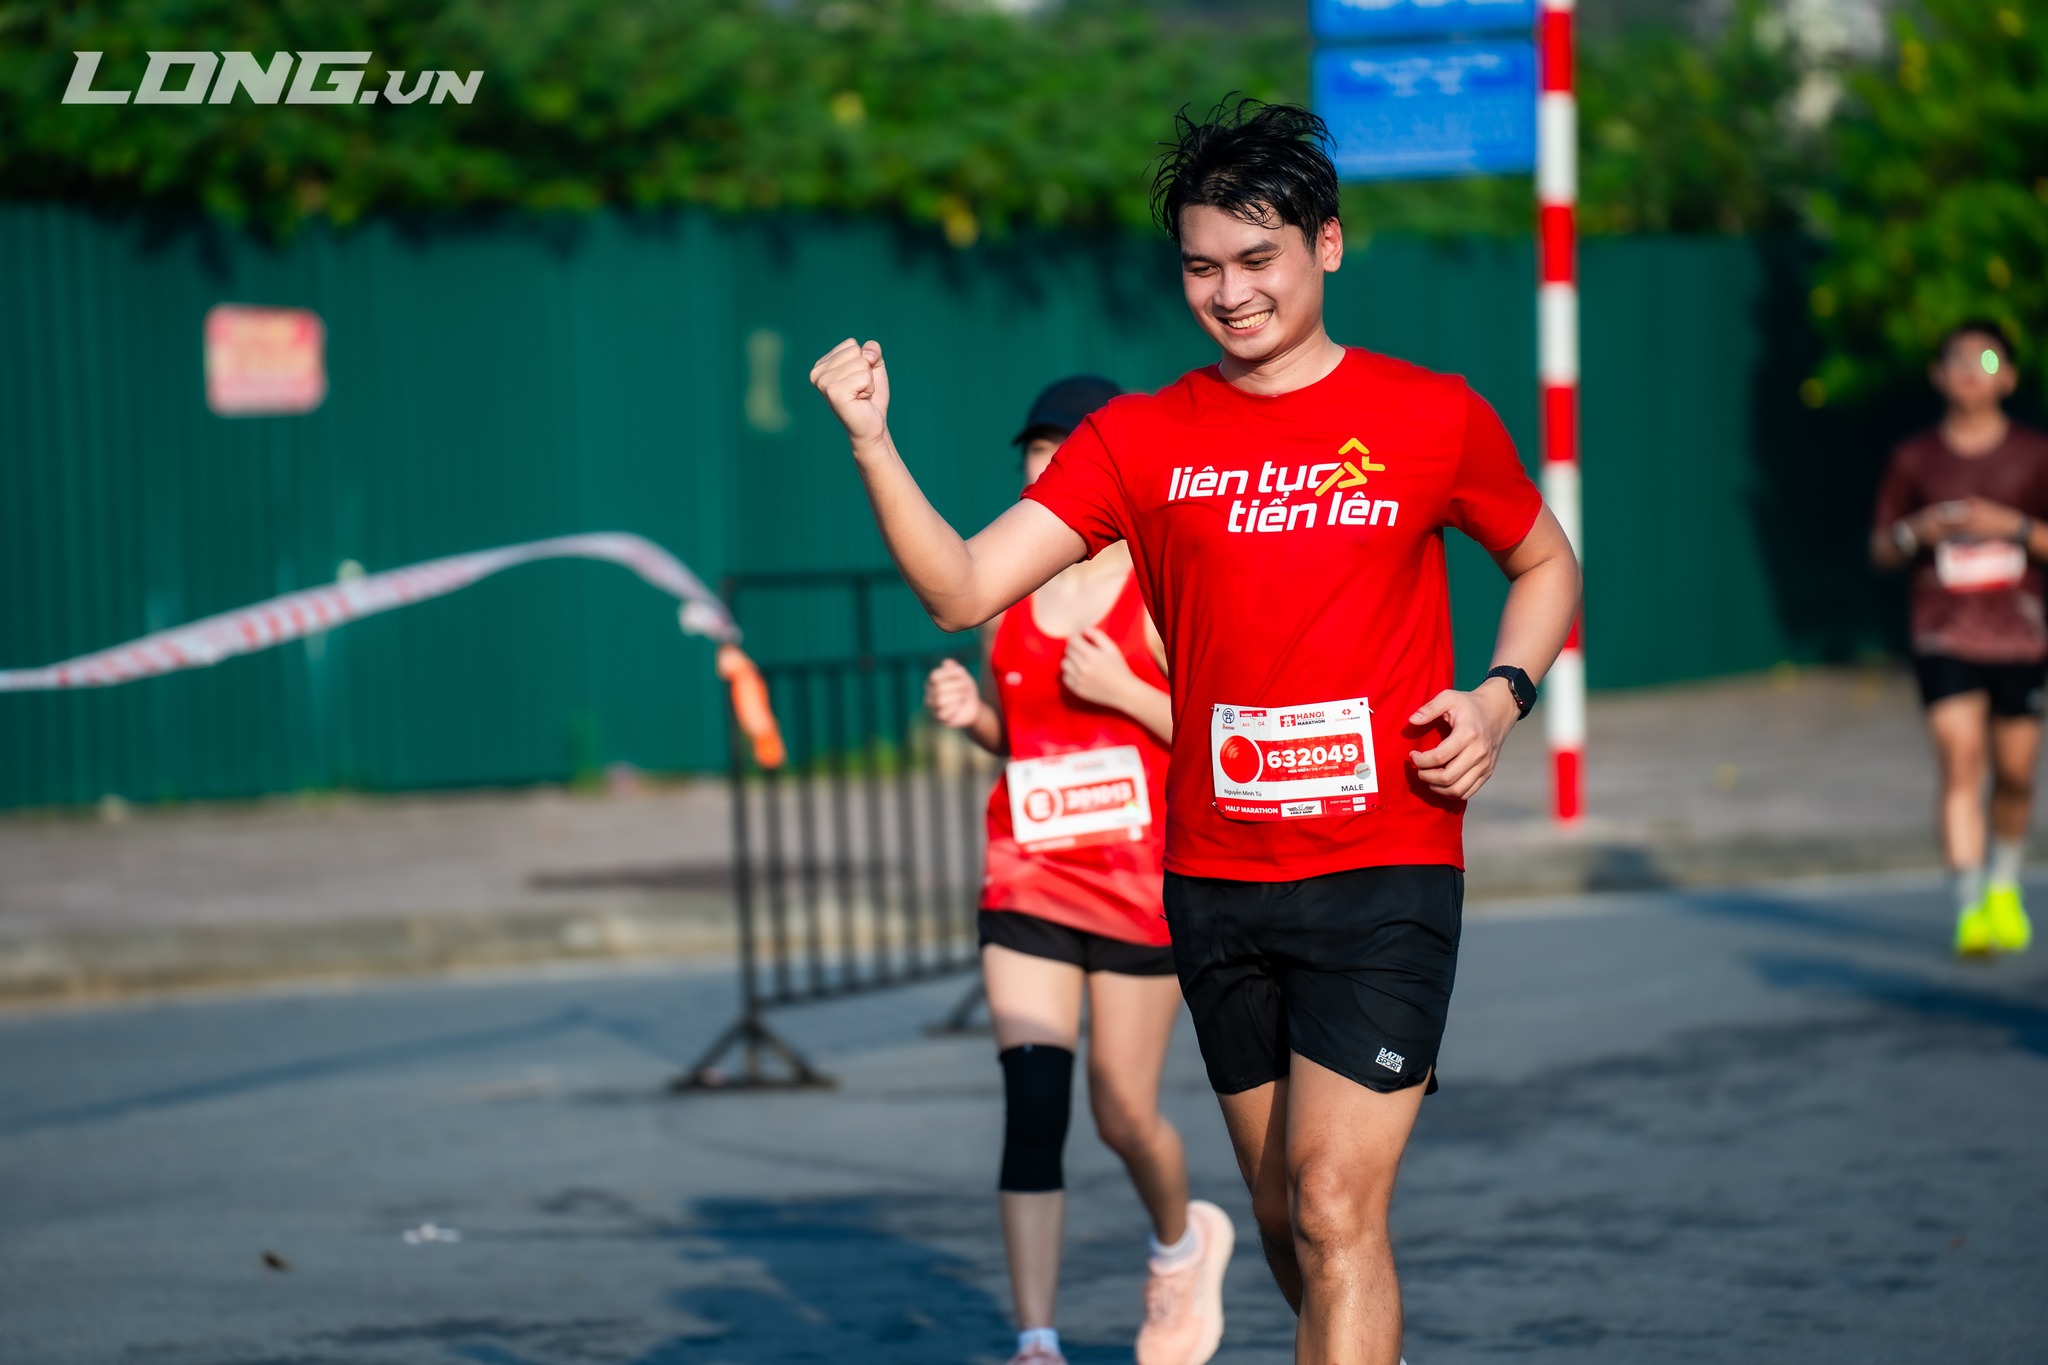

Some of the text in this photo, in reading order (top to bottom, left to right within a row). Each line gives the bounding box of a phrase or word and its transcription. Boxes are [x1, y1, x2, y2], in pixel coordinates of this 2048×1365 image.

[1168, 465, 1249, 501] liên
[1227, 491, 1399, 533] tiến lên
[1296, 711, 1325, 720] HANOI
[1266, 744, 1359, 768] 632049
[1341, 783, 1364, 792] MALE
[1377, 1056, 1401, 1071] SPORT
[1379, 1047, 1406, 1066] BAZIK
